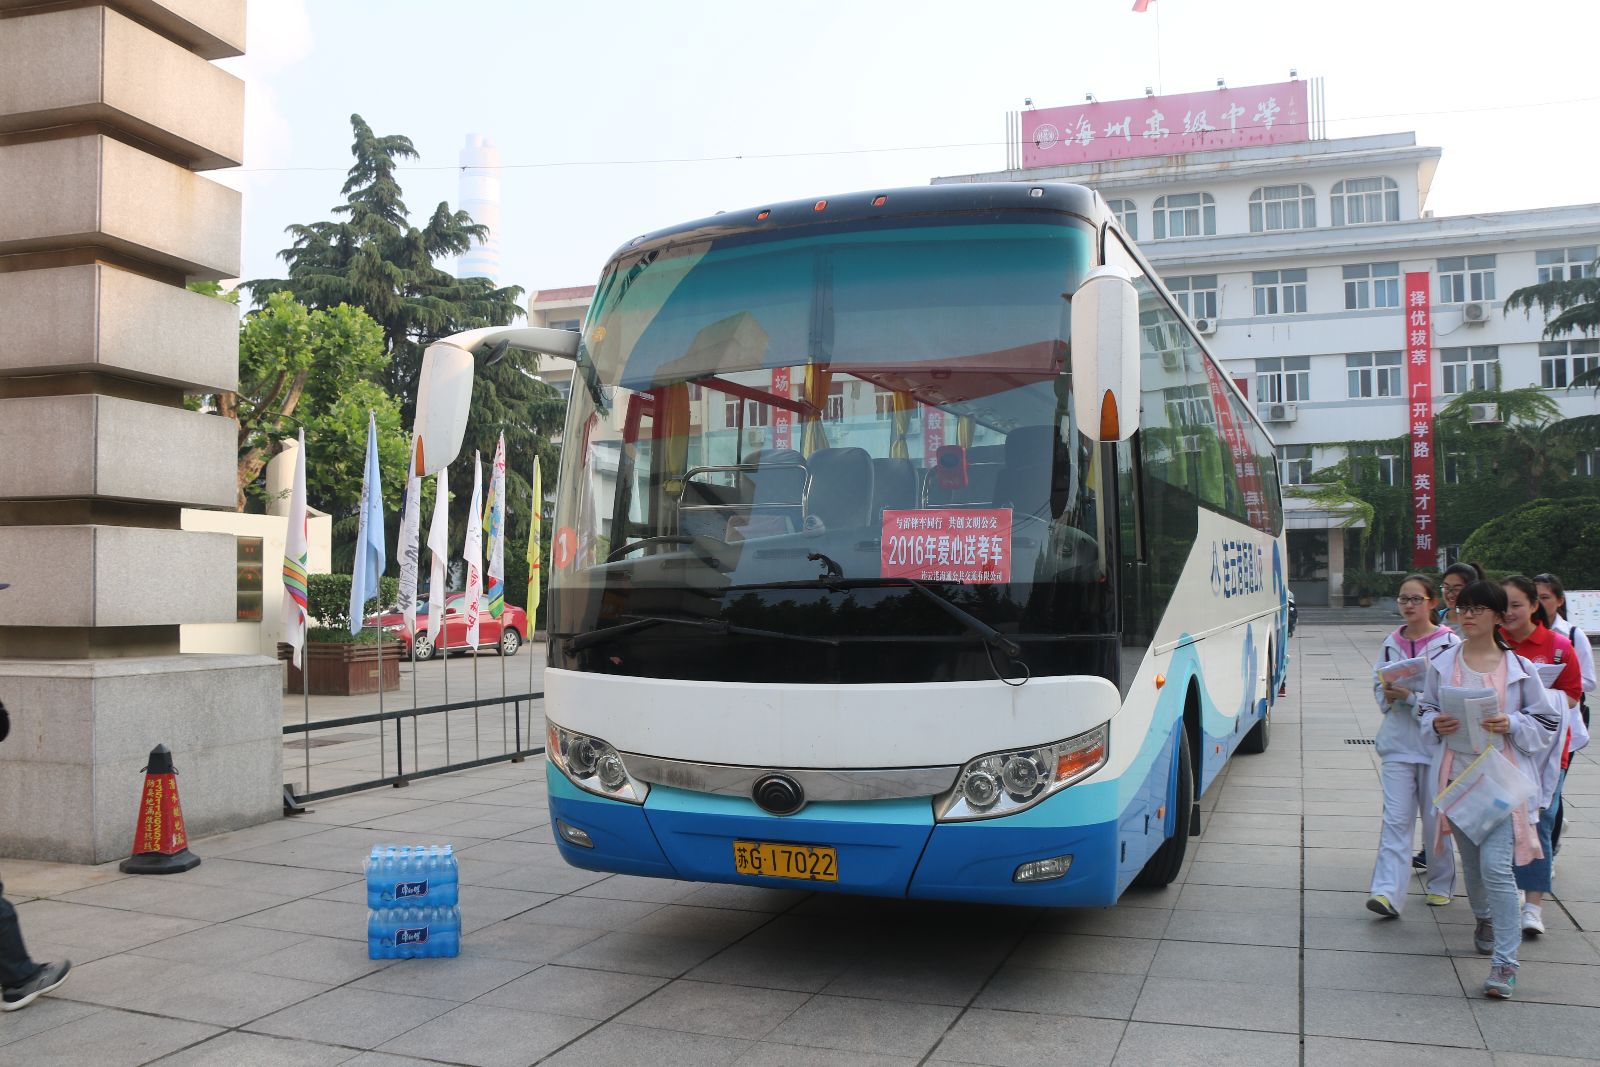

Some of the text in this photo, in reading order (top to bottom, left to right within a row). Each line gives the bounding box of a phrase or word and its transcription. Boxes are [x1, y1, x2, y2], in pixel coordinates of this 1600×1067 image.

[1410, 290, 1432, 551] 择优拔萃 广开学路 英才于斯
[948, 516, 998, 529] 共创文明公交
[888, 534, 1003, 566] 2016年爱心送考车
